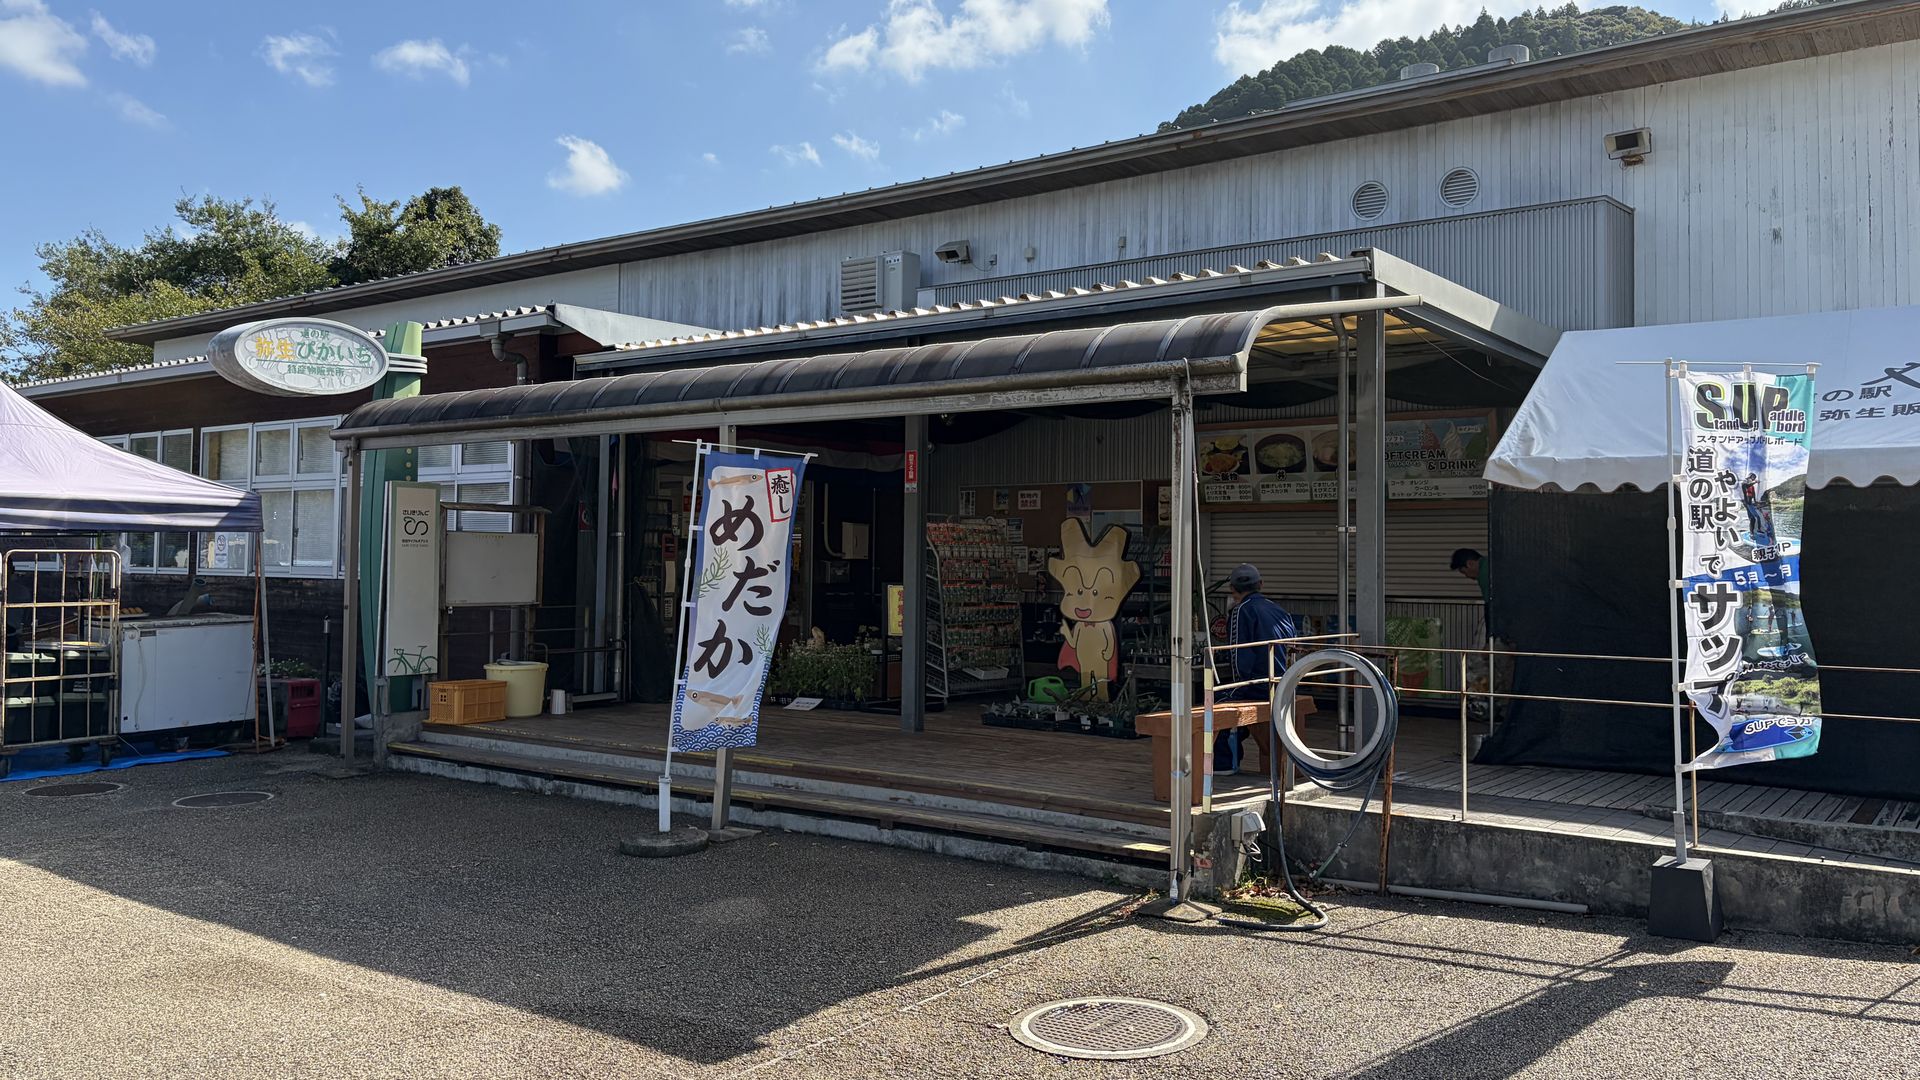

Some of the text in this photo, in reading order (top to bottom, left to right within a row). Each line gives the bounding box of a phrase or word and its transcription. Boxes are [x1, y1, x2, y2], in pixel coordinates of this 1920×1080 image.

[300, 328, 330, 340] 道の駅
[255, 337, 372, 364] 弥生ぴかいち
[288, 364, 345, 377] 特産物販売所
[1814, 385, 1892, 402] の駅
[1696, 383, 1789, 431] SUP
[1770, 410, 1805, 421] addle
[1776, 421, 1806, 432] bord
[1385, 450, 1446, 460] OFTCREAM
[1440, 460, 1477, 470] DRINK
[770, 474, 792, 514] 癒し
[1688, 448, 1716, 530] 道の駅
[693, 495, 781, 680] めだか
